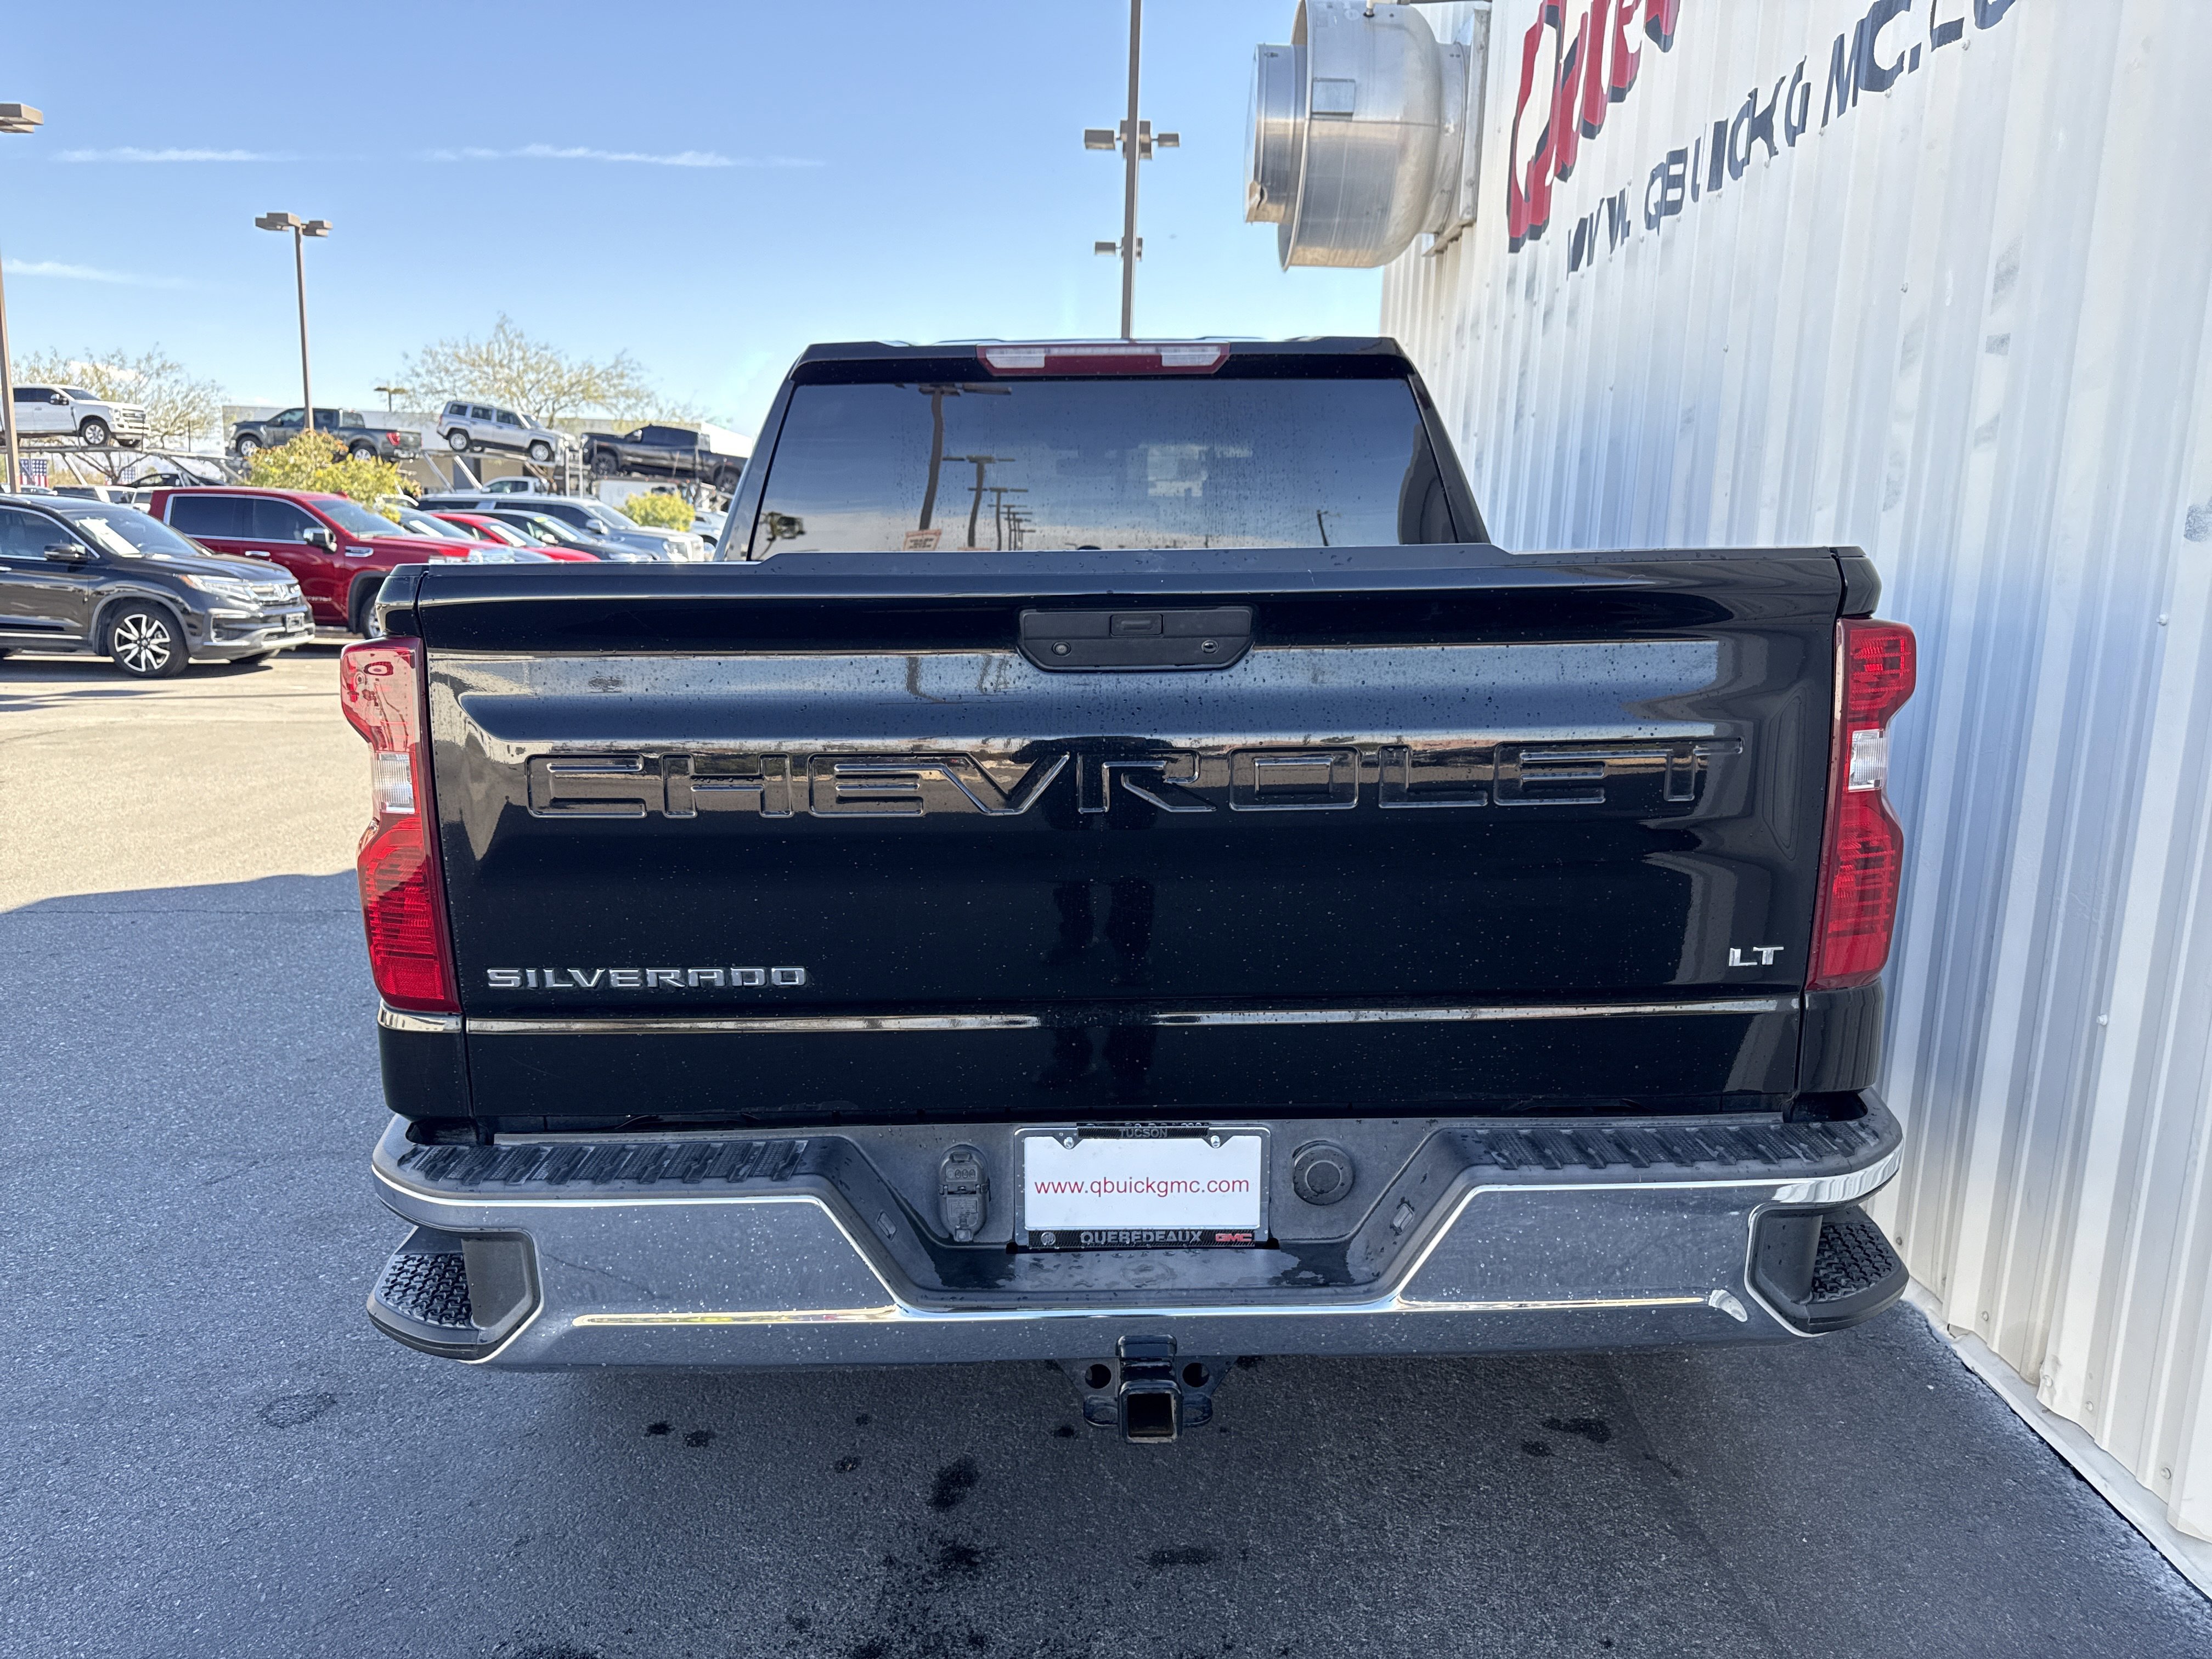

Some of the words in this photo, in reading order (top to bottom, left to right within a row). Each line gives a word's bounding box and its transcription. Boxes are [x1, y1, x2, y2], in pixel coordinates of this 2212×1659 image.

[1506, 0, 1681, 253] Que
[525, 736, 1743, 819] CHEVROLET
[1729, 946, 1784, 967] LT
[487, 967, 808, 988] SILVERADO
[1119, 1128, 1168, 1138] TUCSON
[1035, 1177, 1250, 1198] www.qbuickgmc.com
[1080, 1231, 1203, 1245] QUEBEDEAUX
[1215, 1233, 1252, 1242] GMC
